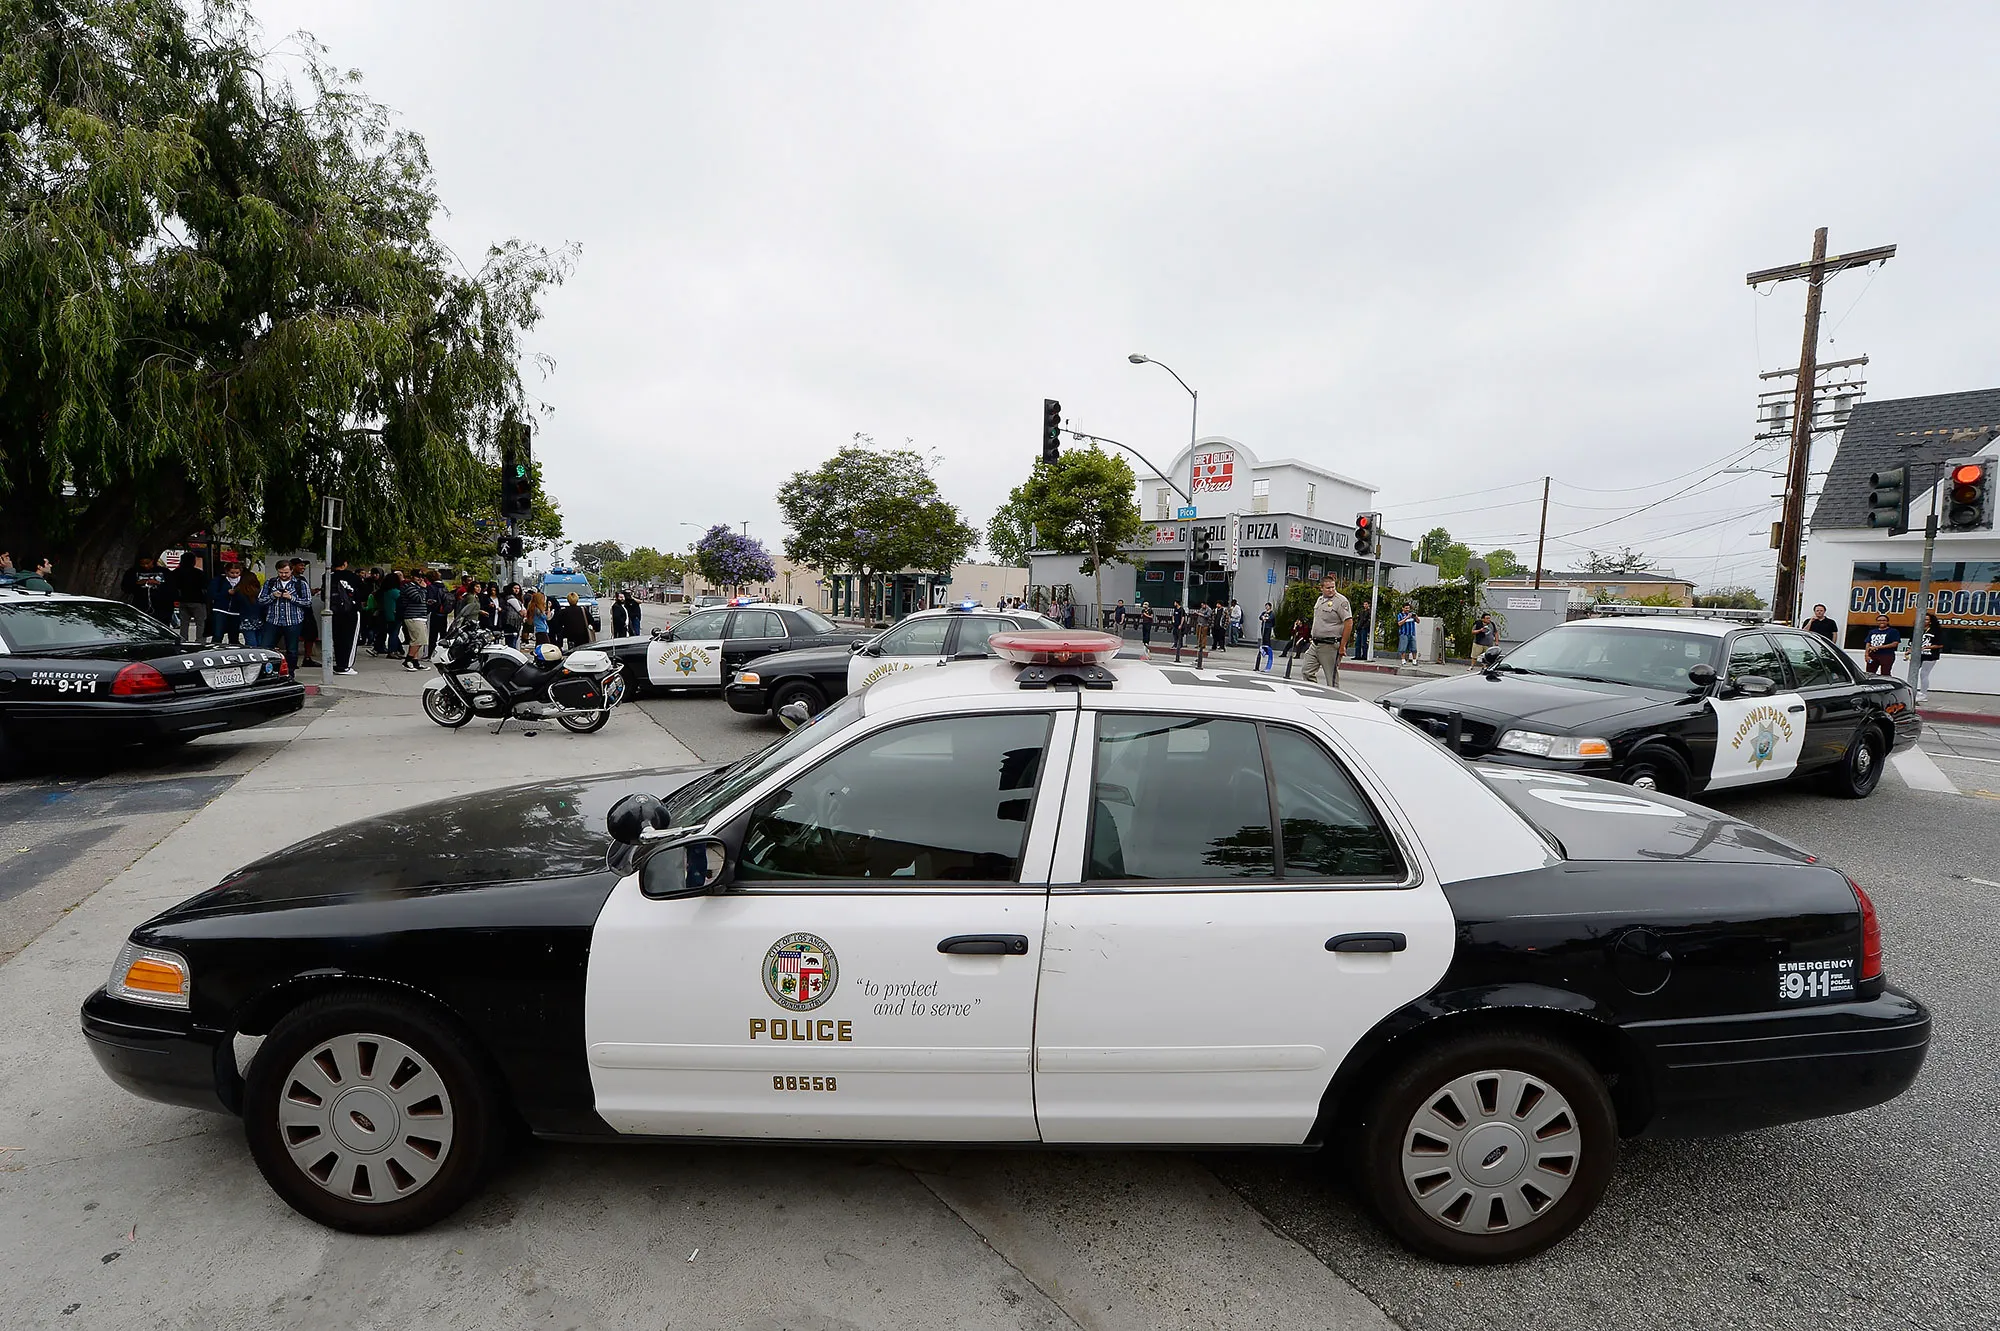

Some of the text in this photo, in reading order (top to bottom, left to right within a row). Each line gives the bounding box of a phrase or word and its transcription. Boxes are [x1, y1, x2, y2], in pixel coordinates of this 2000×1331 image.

[1213, 451, 1234, 463] BLOCK
[1193, 477, 1231, 494] Pizza
[1247, 523, 1279, 539] PIZZA
[1303, 526, 1318, 543] GREY
[1319, 529, 1335, 547] BLOCK
[1336, 532, 1350, 549] PIZZA
[182, 653, 268, 669] POLICE
[658, 644, 712, 666] HIGHWAY PATROL
[32, 671, 99, 679] EMERGENCY
[58, 679, 96, 693] 9-1-1
[1731, 706, 1793, 749] HIGHWAY PATROL
[769, 941, 783, 958] CITY
[794, 934, 807, 942] LOS
[808, 936, 834, 960] ANGELES
[1779, 960, 1853, 971] EMERGENCY
[883, 980, 938, 1000] protect
[777, 997, 806, 1010] FOUNDED
[873, 998, 905, 1016] and
[911, 1000, 926, 1016] to
[749, 1018, 853, 1042] POLICE
[773, 1075, 837, 1092] 88558
